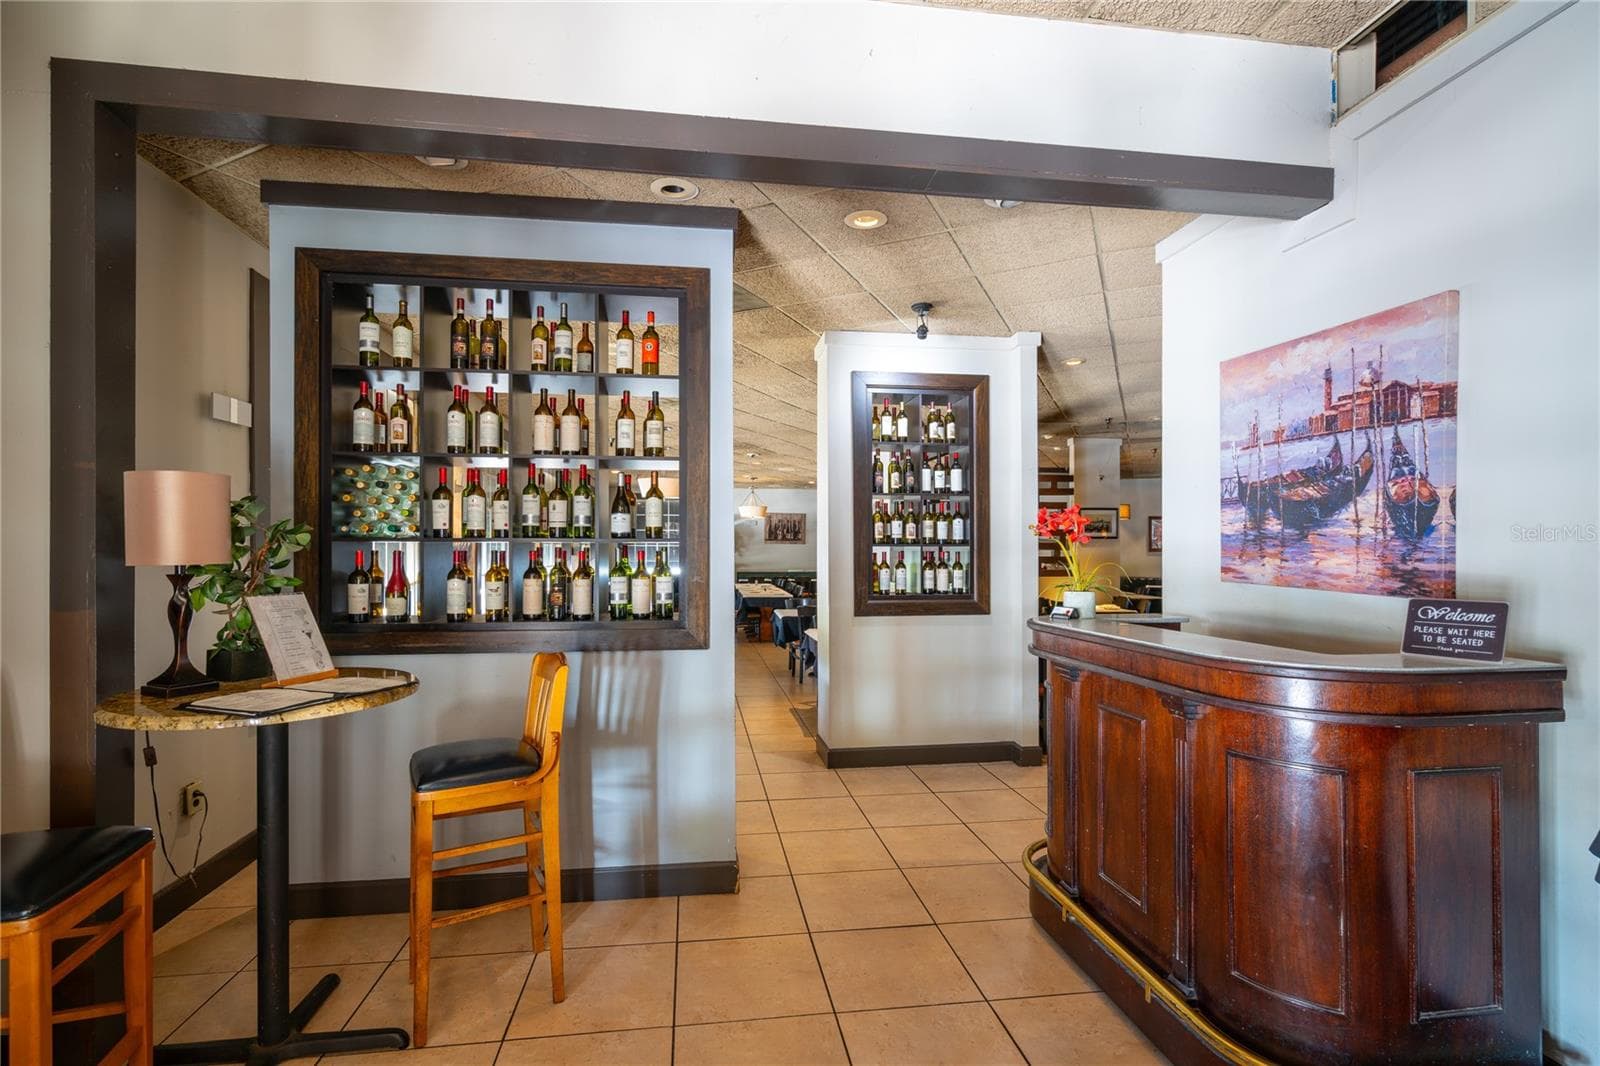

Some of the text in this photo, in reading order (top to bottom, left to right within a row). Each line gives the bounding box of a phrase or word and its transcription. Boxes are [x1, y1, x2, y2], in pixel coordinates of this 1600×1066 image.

[1418, 606, 1496, 623] Welcome
[1413, 625, 1496, 638] PLEASE WAIT HERE
[1423, 634, 1484, 646] TO BE SEATED
